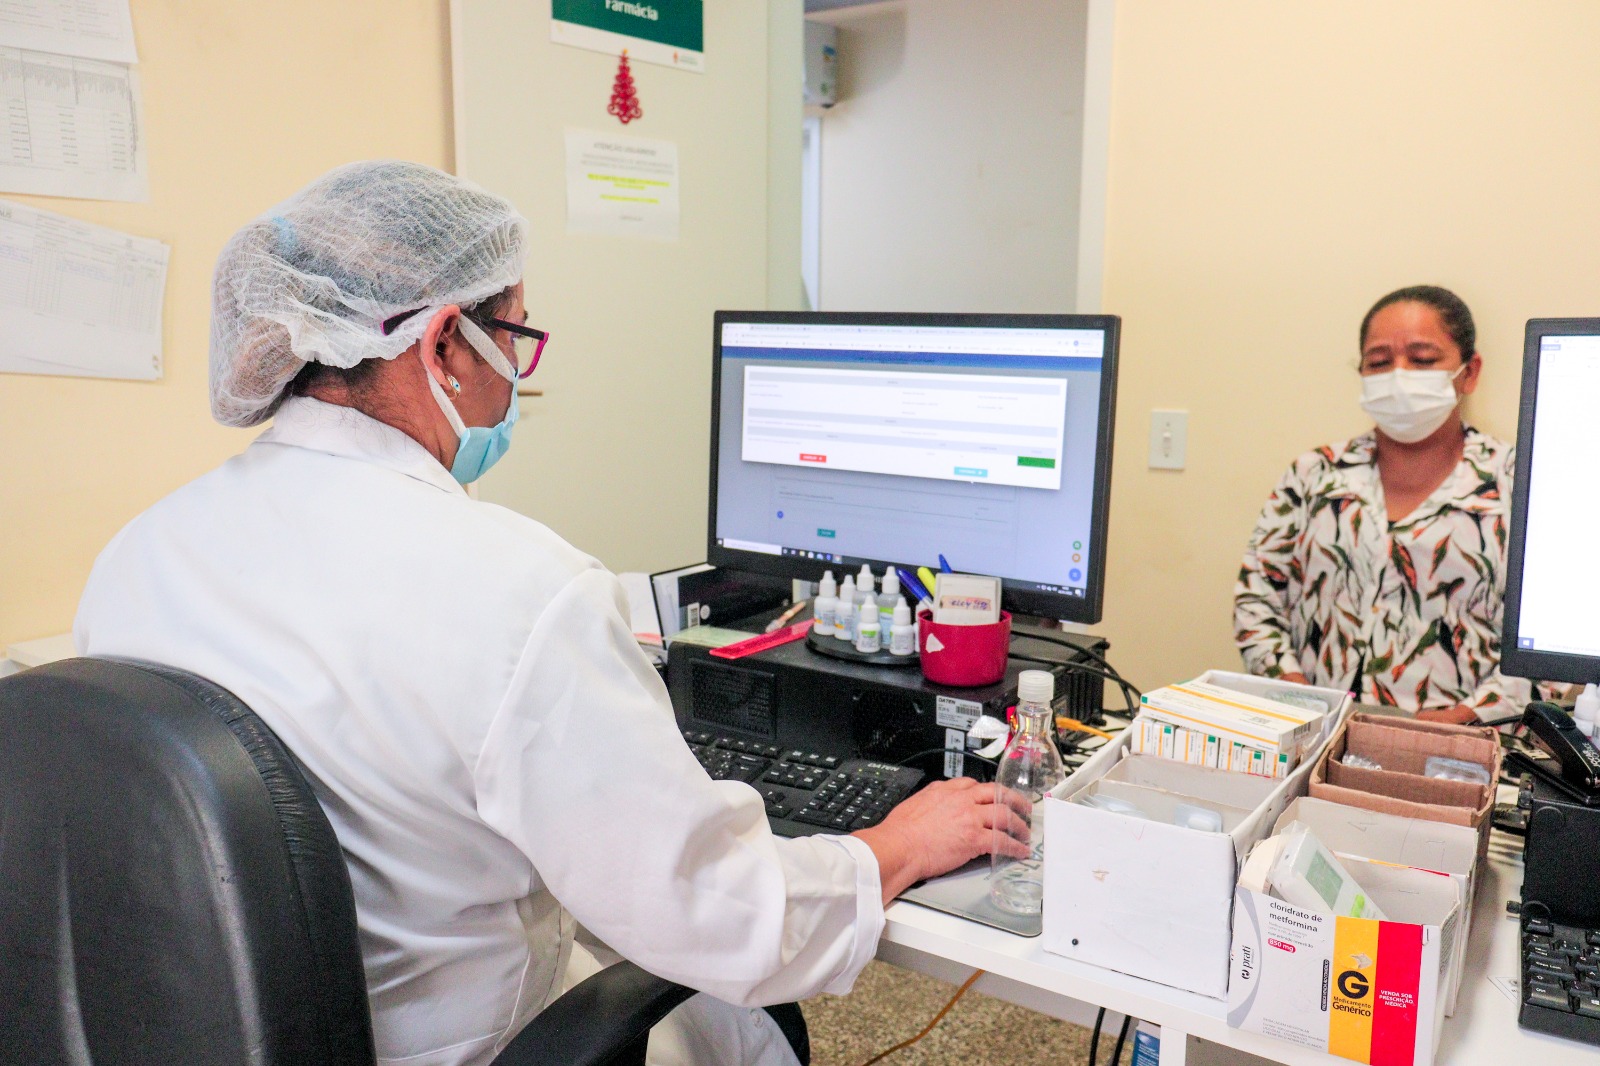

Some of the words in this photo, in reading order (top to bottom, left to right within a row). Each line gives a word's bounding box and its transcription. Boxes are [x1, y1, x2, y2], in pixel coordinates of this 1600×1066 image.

[1270, 902, 1309, 919] cloridrato
[1311, 914, 1322, 922] de
[1269, 913, 1318, 932] metformina
[1269, 939, 1282, 947] 850
[1282, 943, 1294, 952] mg
[1242, 945, 1253, 969] prati
[1337, 970, 1369, 999] G
[1333, 996, 1371, 1008] Medicamento
[1333, 1001, 1371, 1017] Genérico
